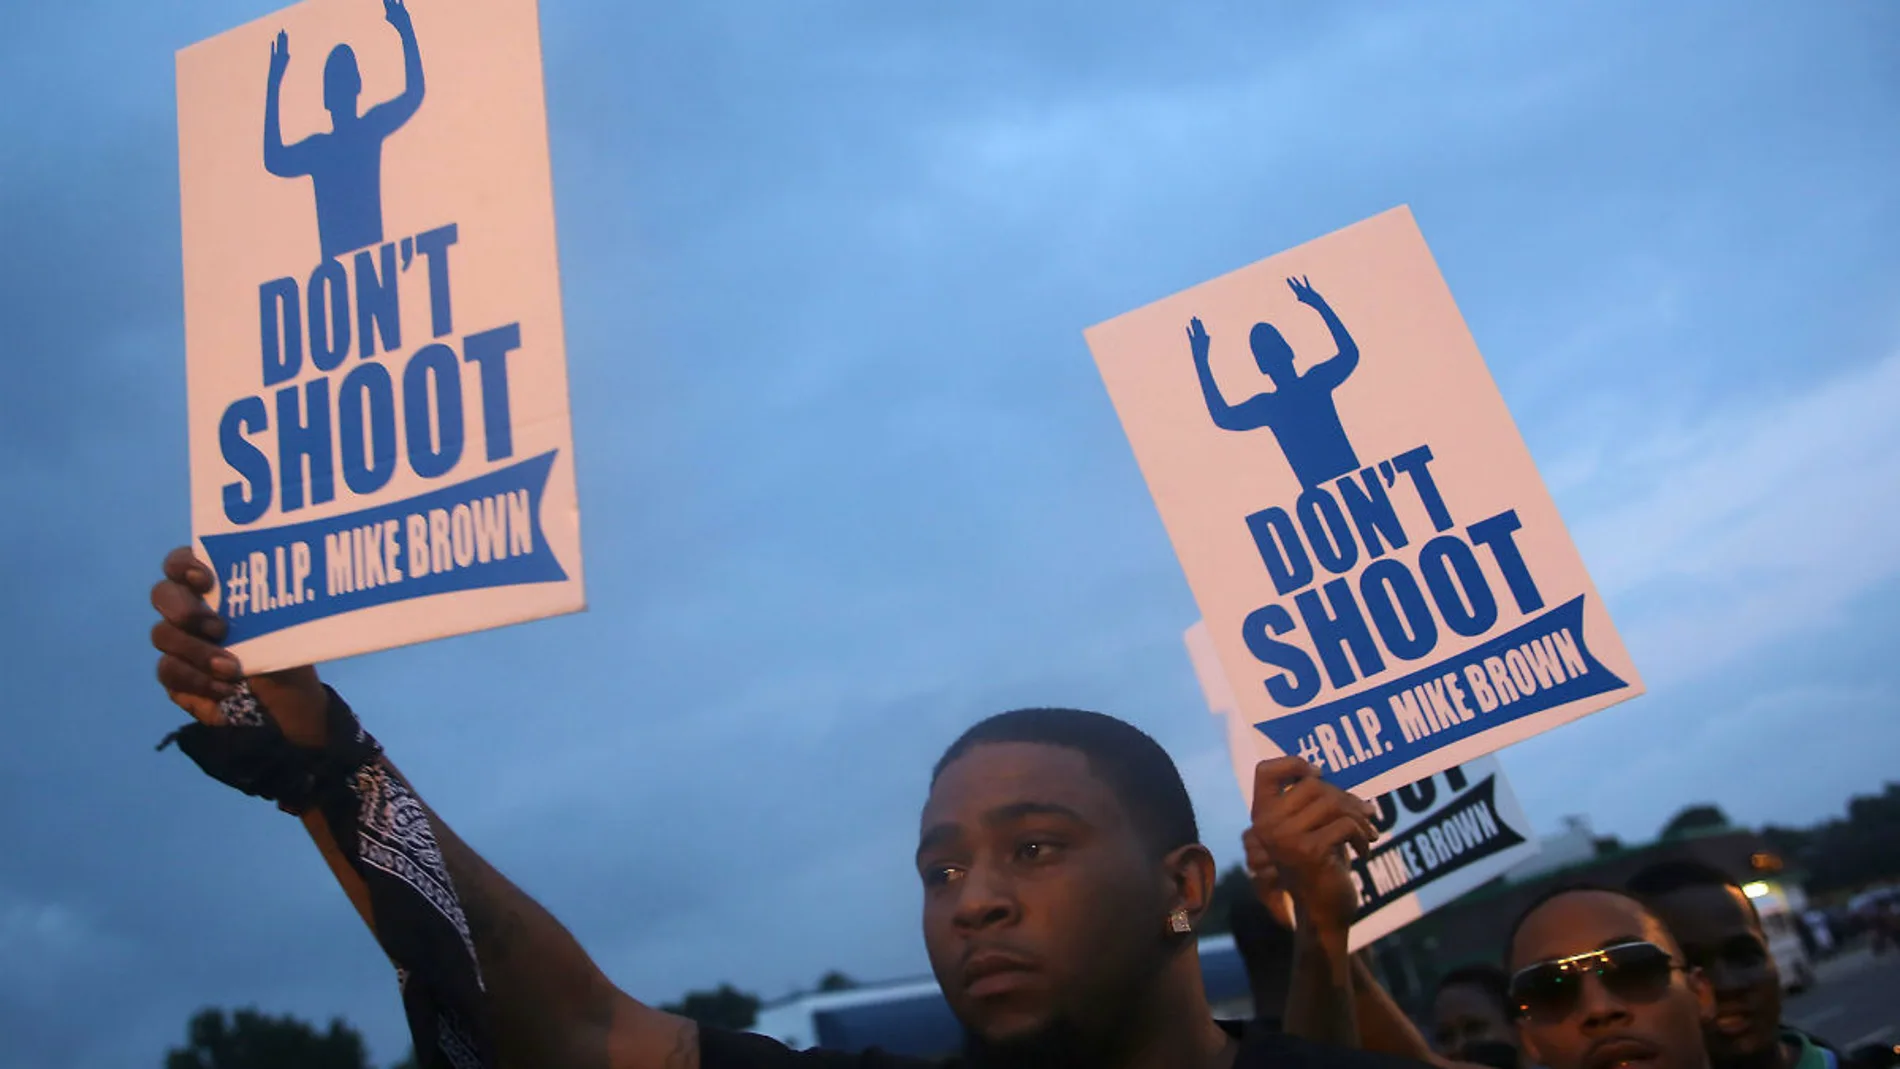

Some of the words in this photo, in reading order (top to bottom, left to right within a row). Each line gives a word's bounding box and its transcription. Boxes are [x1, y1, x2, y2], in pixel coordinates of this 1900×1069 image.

[258, 222, 458, 387] DON'T
[218, 321, 521, 525] SHOOT
[227, 541, 315, 618] #R.I.P.
[324, 519, 403, 597] MIKE
[406, 489, 533, 579] BROWN
[1244, 444, 1454, 596] DON'T
[1242, 508, 1545, 709] SHOOT
[1298, 706, 1394, 773] #R.I.P.
[1388, 672, 1475, 744] MIKE
[1463, 628, 1588, 713] BROWN
[1366, 840, 1425, 897] MIKE
[1414, 799, 1499, 870] BROWN
